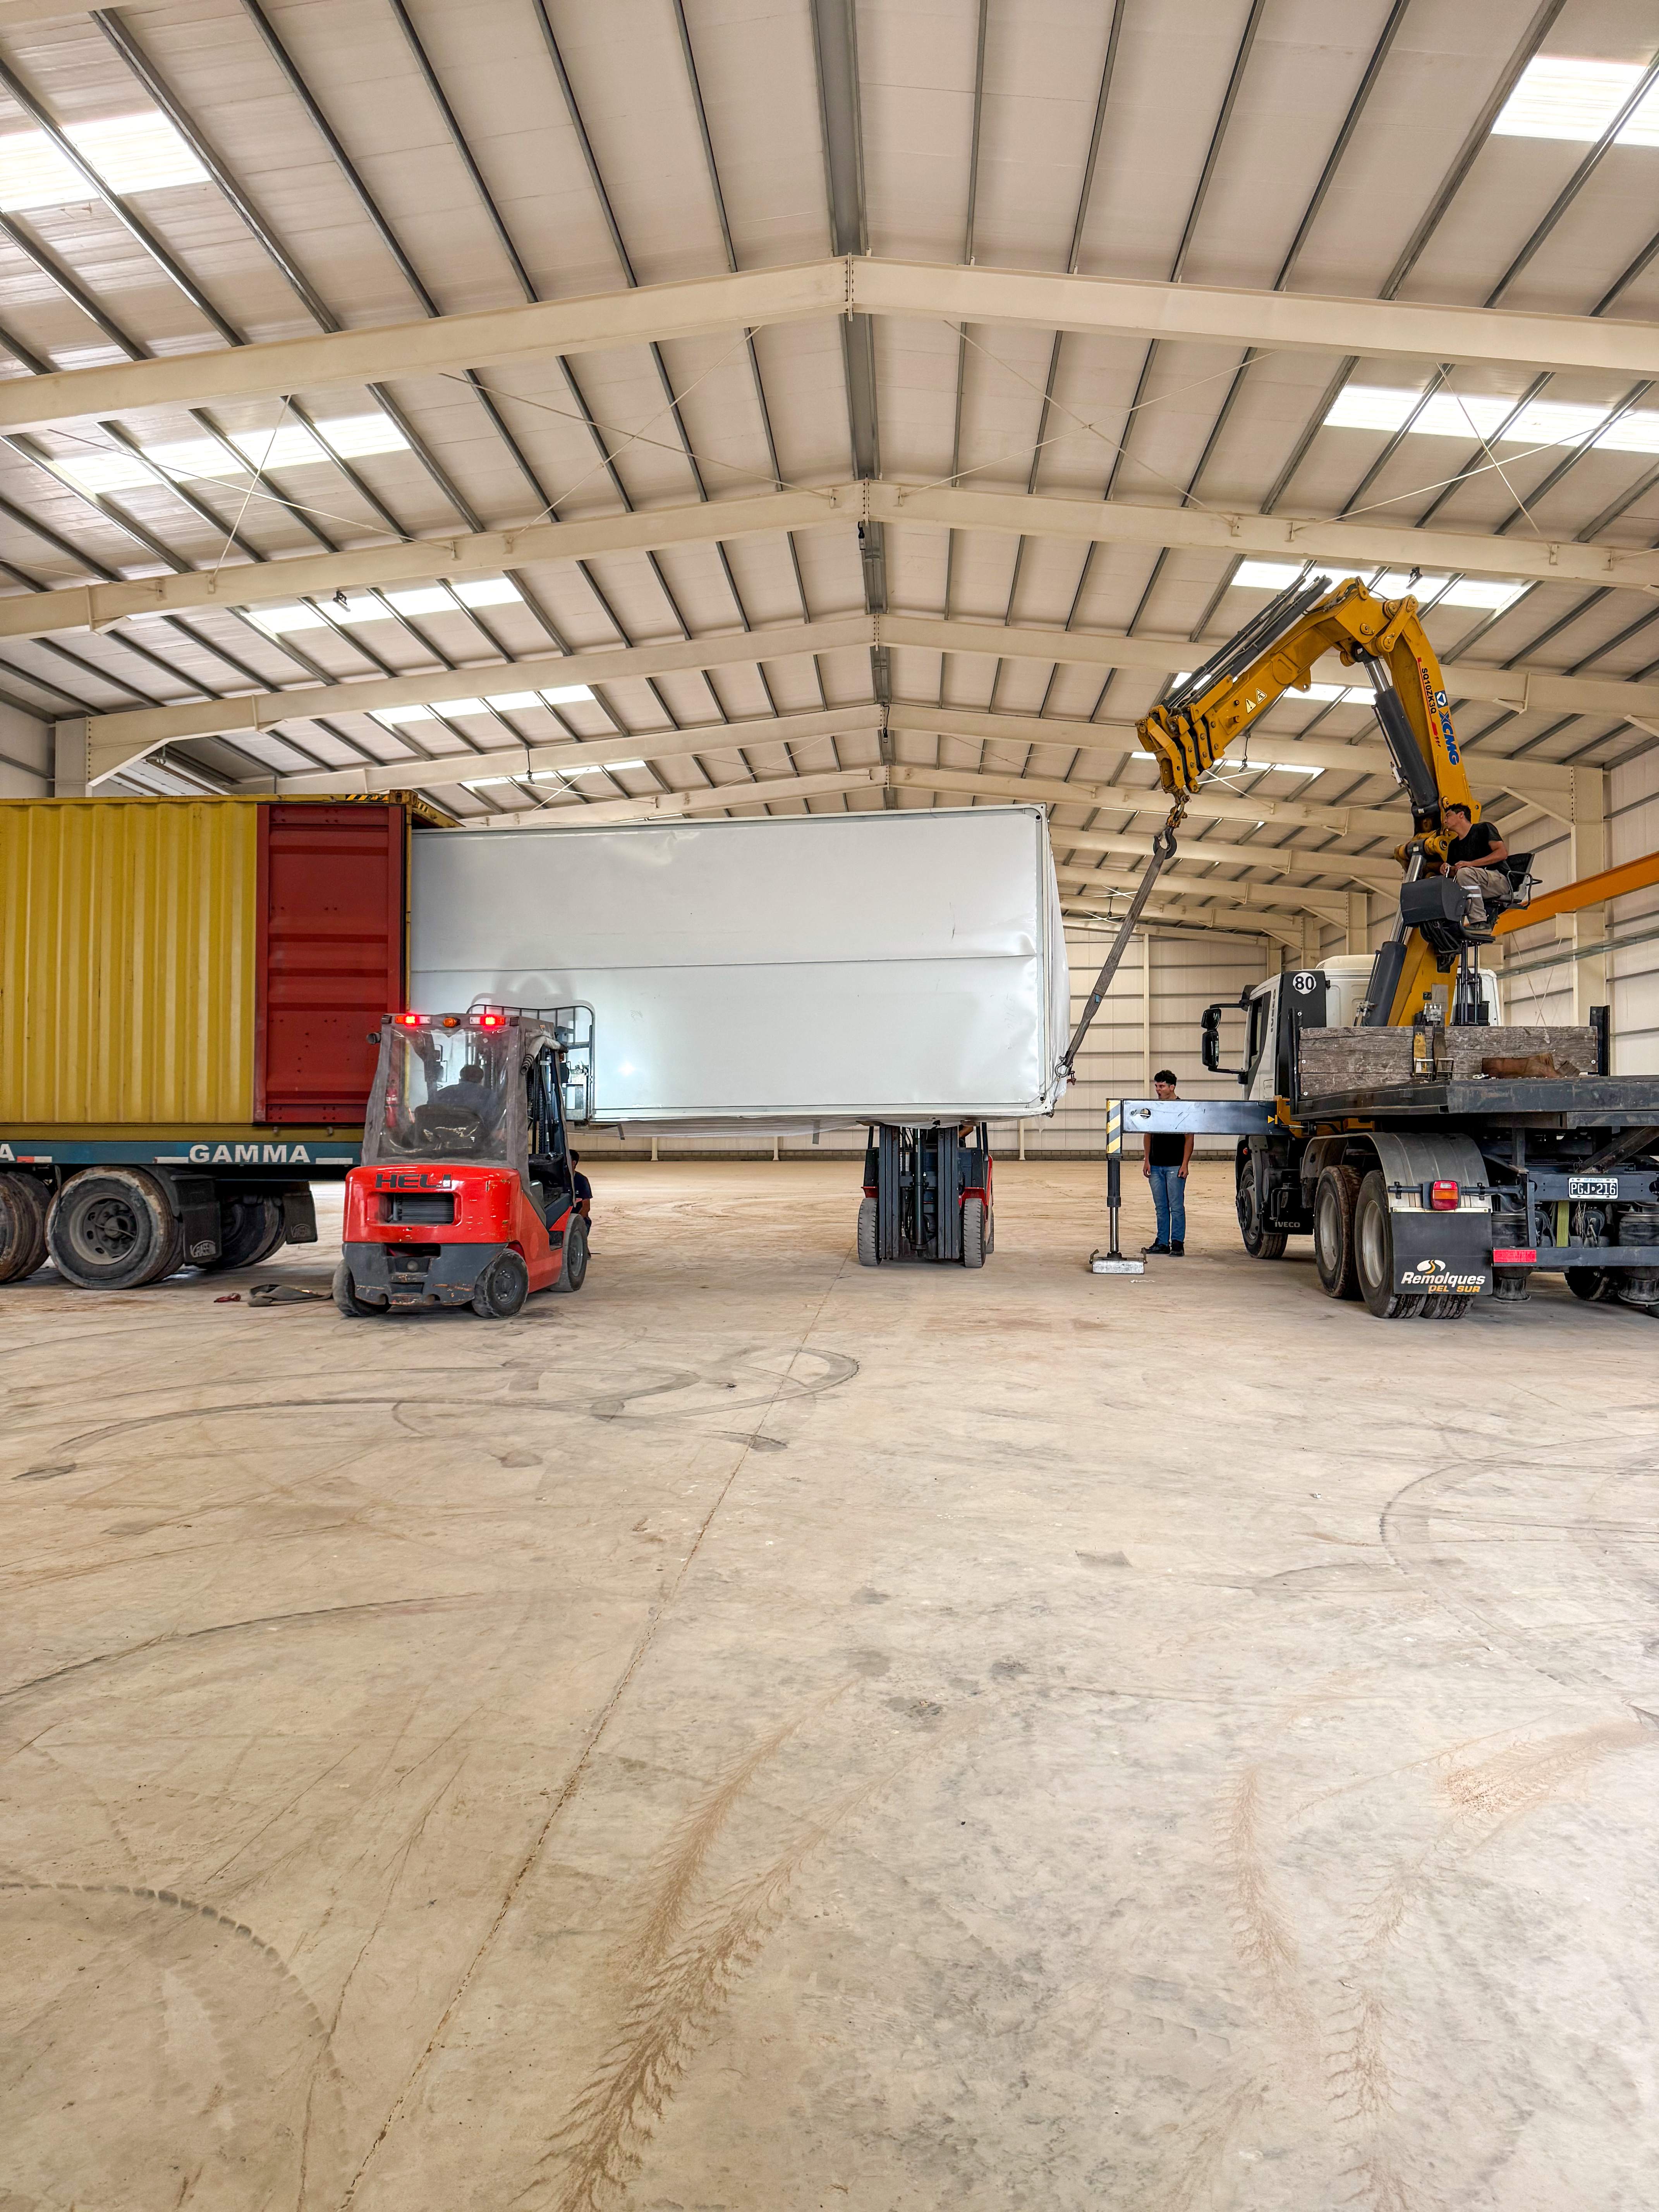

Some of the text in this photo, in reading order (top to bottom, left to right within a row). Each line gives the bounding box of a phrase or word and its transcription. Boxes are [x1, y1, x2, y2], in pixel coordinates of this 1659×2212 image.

[1422, 668, 1437, 714] SQ10ZK3Q
[1438, 710, 1460, 765] XCMG
[1295, 976, 1314, 990] 80
[189, 1144, 311, 1163] GAMMA
[376, 1174, 452, 1188] HELI
[1401, 1272, 1486, 1288] Remolques
